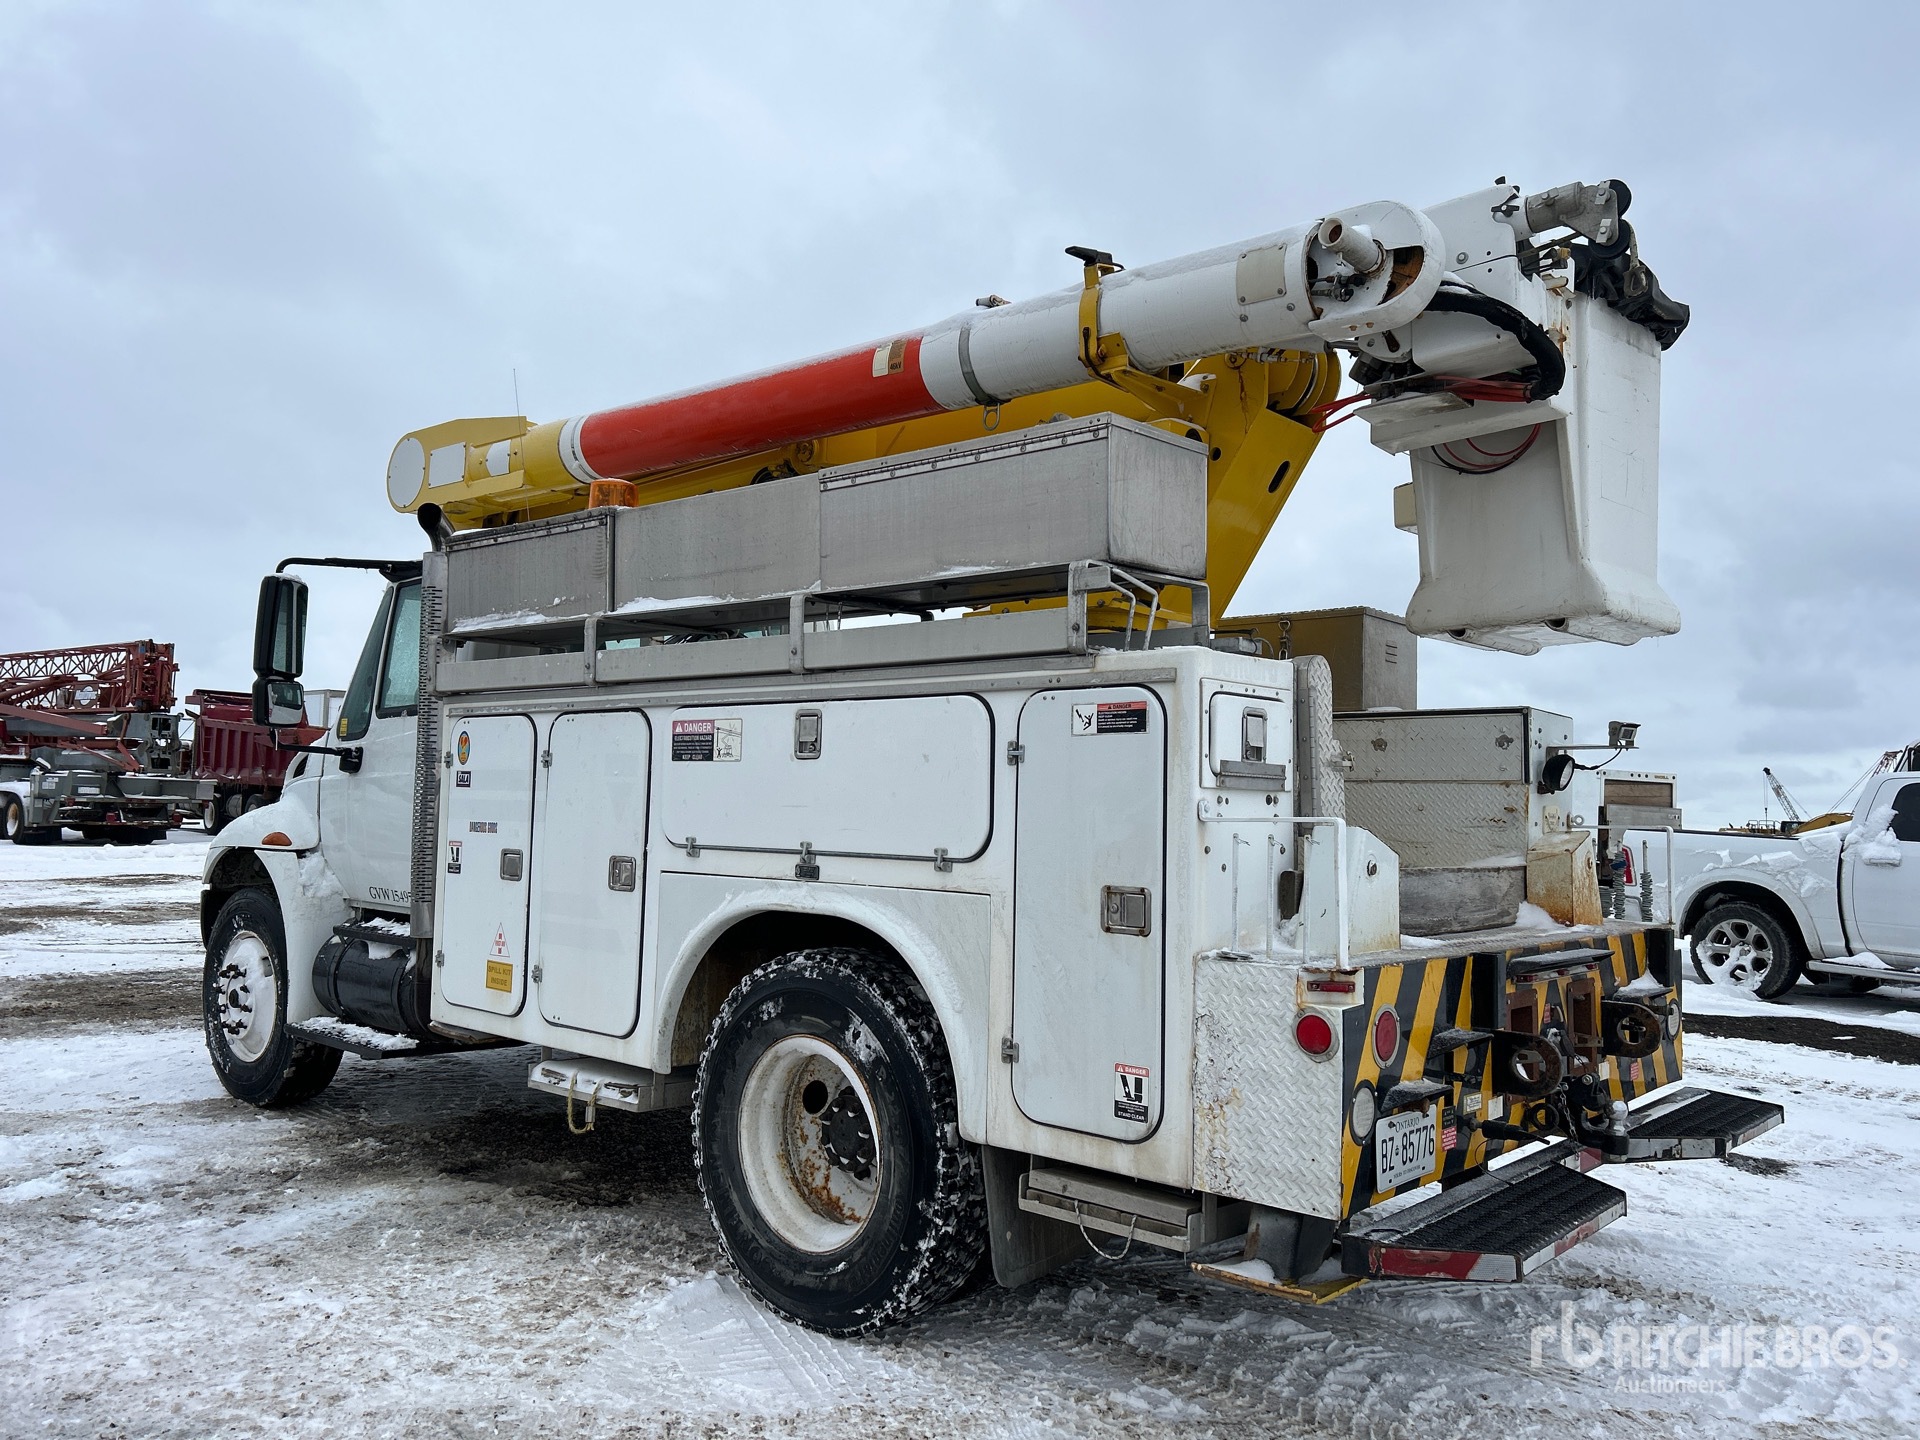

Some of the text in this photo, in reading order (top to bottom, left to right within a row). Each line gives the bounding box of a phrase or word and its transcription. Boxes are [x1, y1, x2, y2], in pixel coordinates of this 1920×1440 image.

[684, 722, 712, 732] DANGER
[369, 886, 390, 901] GVW
[1395, 1117, 1420, 1133] ONTARIO
[1401, 1123, 1436, 1166] 85776
